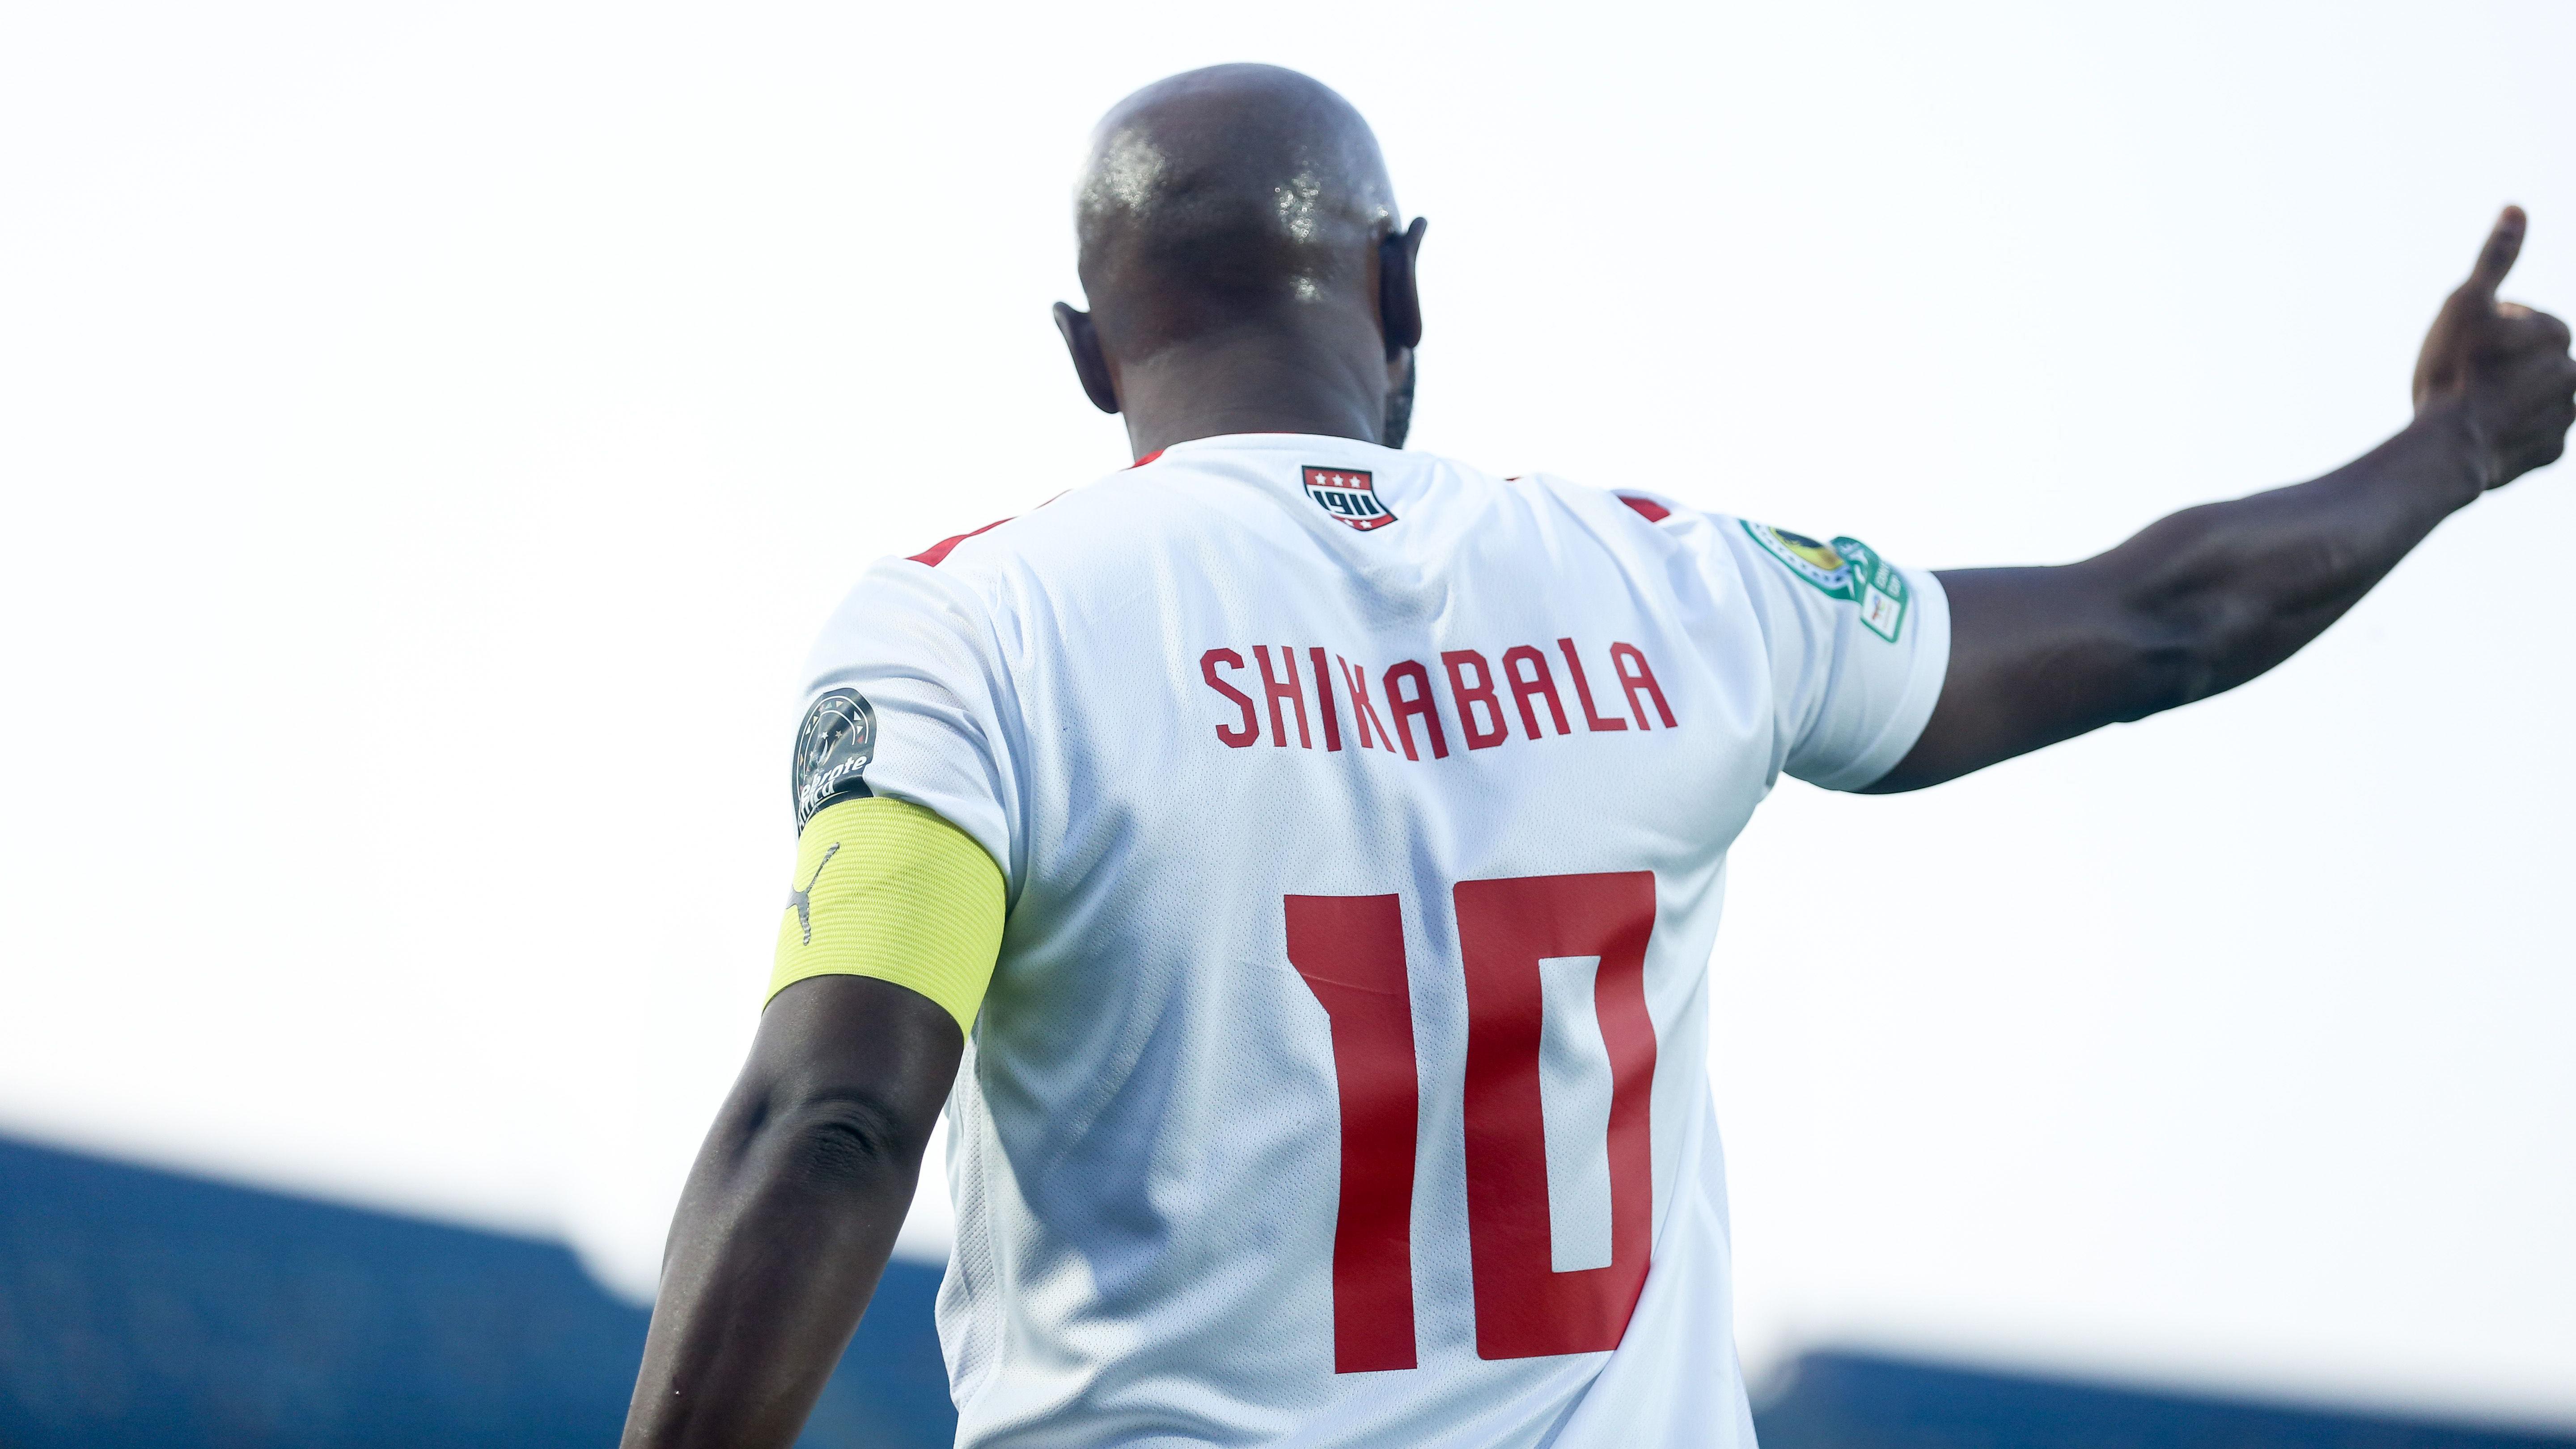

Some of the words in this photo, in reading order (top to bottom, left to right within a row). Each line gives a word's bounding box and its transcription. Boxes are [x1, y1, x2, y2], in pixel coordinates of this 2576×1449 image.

[1313, 490, 1380, 515] 1911
[1200, 638, 1678, 761] SHIKABALA
[1284, 870, 1657, 1374] 10
